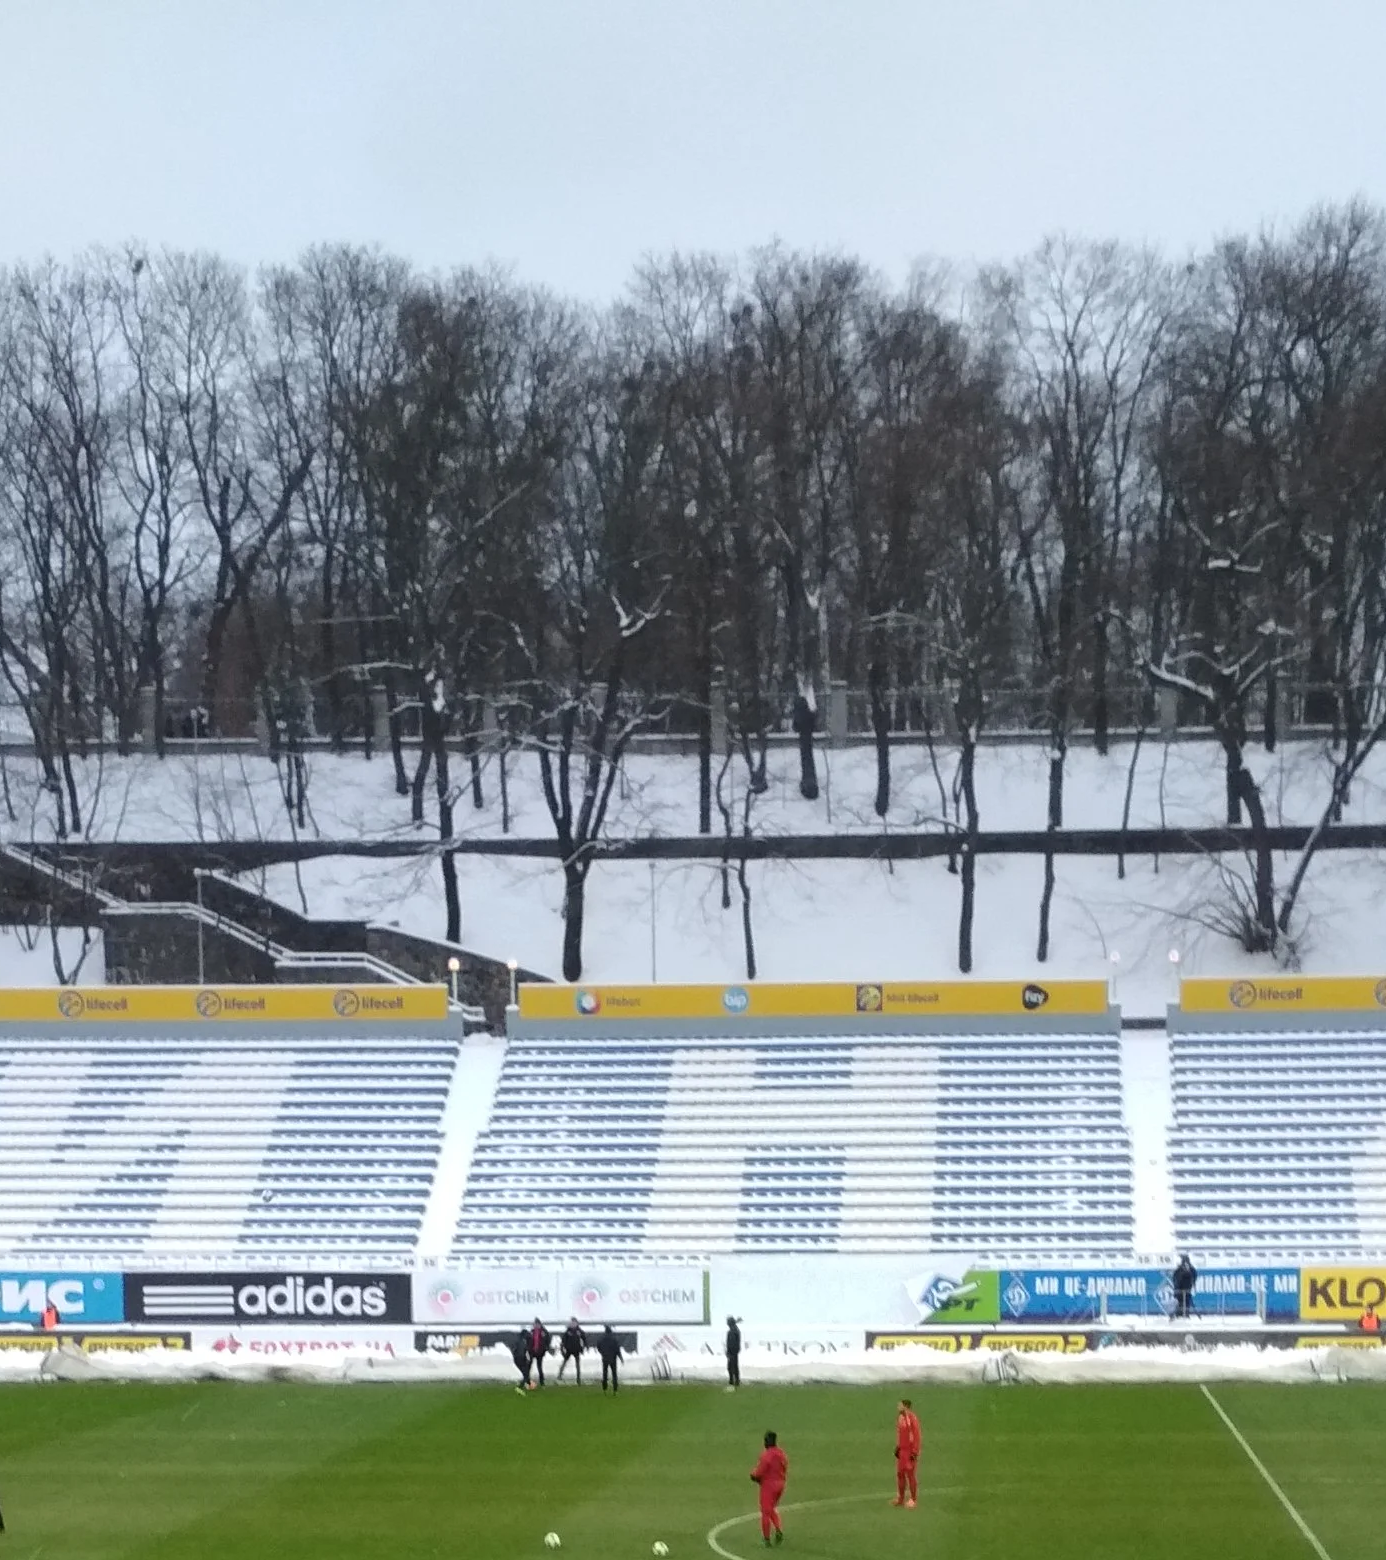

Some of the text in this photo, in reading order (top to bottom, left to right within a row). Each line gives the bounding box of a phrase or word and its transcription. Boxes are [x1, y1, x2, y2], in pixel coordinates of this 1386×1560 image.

[1259, 988, 1302, 1001] lifecell
[86, 997, 127, 1010] lifecell
[224, 997, 265, 1010] lifecell
[362, 996, 403, 1009] lifecell
[1034, 1276, 1059, 1295] МИ
[1273, 1274, 1298, 1293] МИ
[237, 1276, 387, 1316] adidas
[473, 1289, 549, 1305] OSTCHEM
[618, 1289, 695, 1304] OSTCHEM
